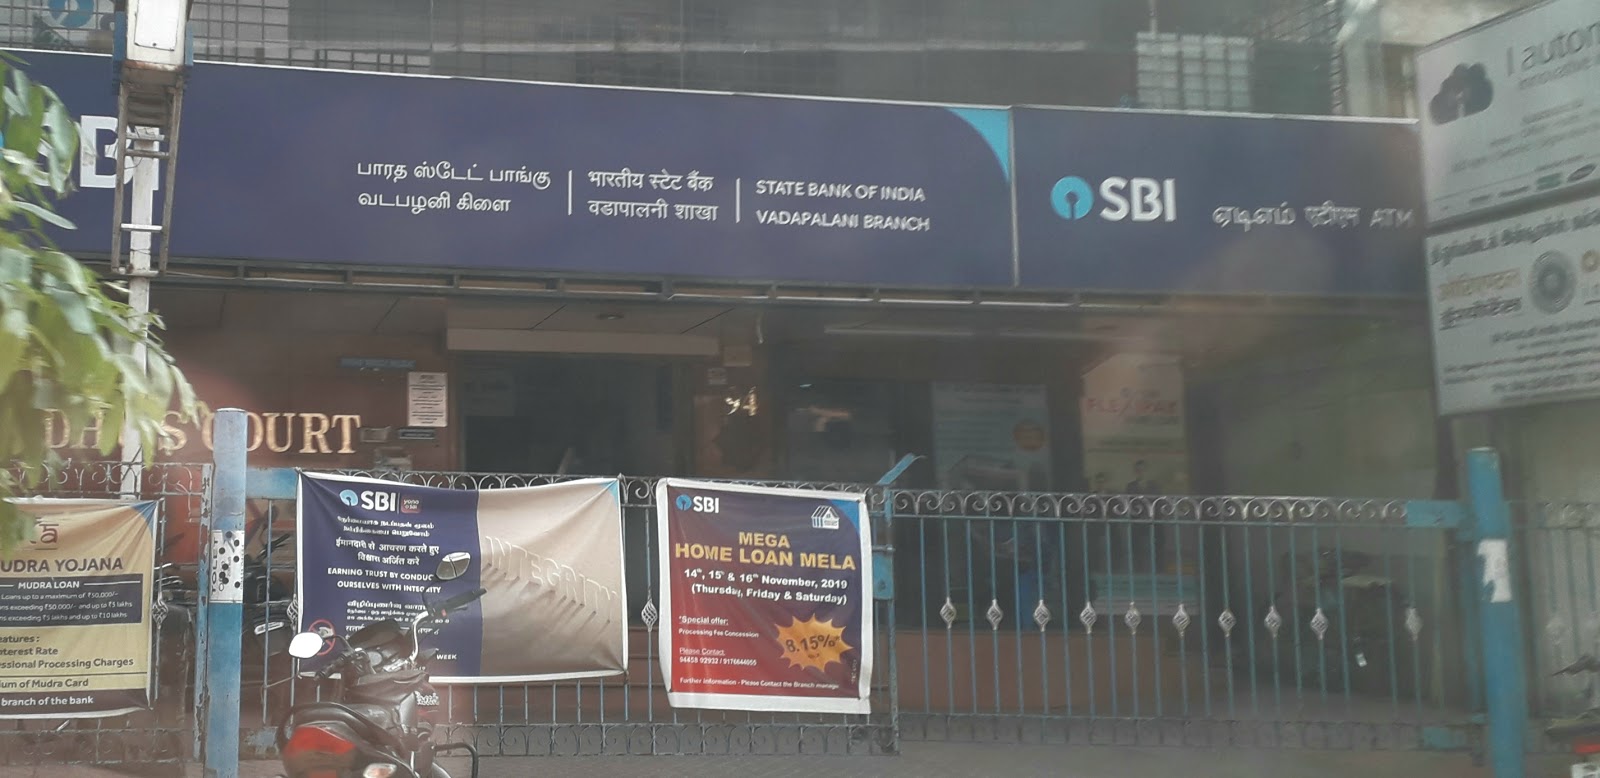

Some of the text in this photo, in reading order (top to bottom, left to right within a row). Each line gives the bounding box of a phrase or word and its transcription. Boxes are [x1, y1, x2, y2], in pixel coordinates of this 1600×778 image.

[357, 160, 551, 190] பாரத ஸ்டேட் பாங்கு
[587, 167, 714, 192] भारतीय स्टेट बैंक
[755, 179, 926, 202] STATE BANK OF INDIA
[357, 190, 511, 215] வடபழனி கிளை
[1099, 176, 1177, 222] SBI
[587, 198, 720, 222] वडापालनी शाखा
[755, 209, 931, 232] VADAPALANI BRANCH
[360, 490, 396, 512] SBI
[693, 496, 720, 513] SBI
[738, 531, 791, 548] MEGA
[379, 543, 407, 552] आचरण
[408, 543, 427, 553] करते
[429, 545, 439, 556] हुए
[675, 543, 856, 571] HOME LOAN MELA
[54, 557, 123, 573] YOJANA
[327, 567, 363, 577] EARNING
[365, 570, 388, 578] TRUST
[389, 571, 399, 579] BY
[18, 580, 80, 589] MUDRA LOAN
[337, 580, 380, 590] OURSELVES
[727, 572, 736, 581] &
[761, 575, 818, 589] November,
[821, 579, 848, 589] 2019
[22, 594, 31, 602] up
[45, 592, 77, 600] maximum
[691, 584, 848, 605] (Thursday, Friday & Saturday)
[10, 604, 43, 612] exceeding
[8, 613, 41, 622] exceeding
[51, 613, 68, 621] lakhs
[69, 612, 80, 620] and
[111, 611, 128, 619] lakhs
[679, 628, 713, 637] Processing
[724, 630, 759, 638] Concession
[35, 647, 58, 656] Rate
[679, 647, 700, 655] Please
[38, 658, 92, 670] Processing
[93, 657, 134, 668] Charges
[19, 679, 30, 688] of
[32, 680, 63, 688] Mudra
[64, 678, 89, 687] Card
[680, 677, 702, 685] Further
[1, 695, 94, 707] branch of the bank
